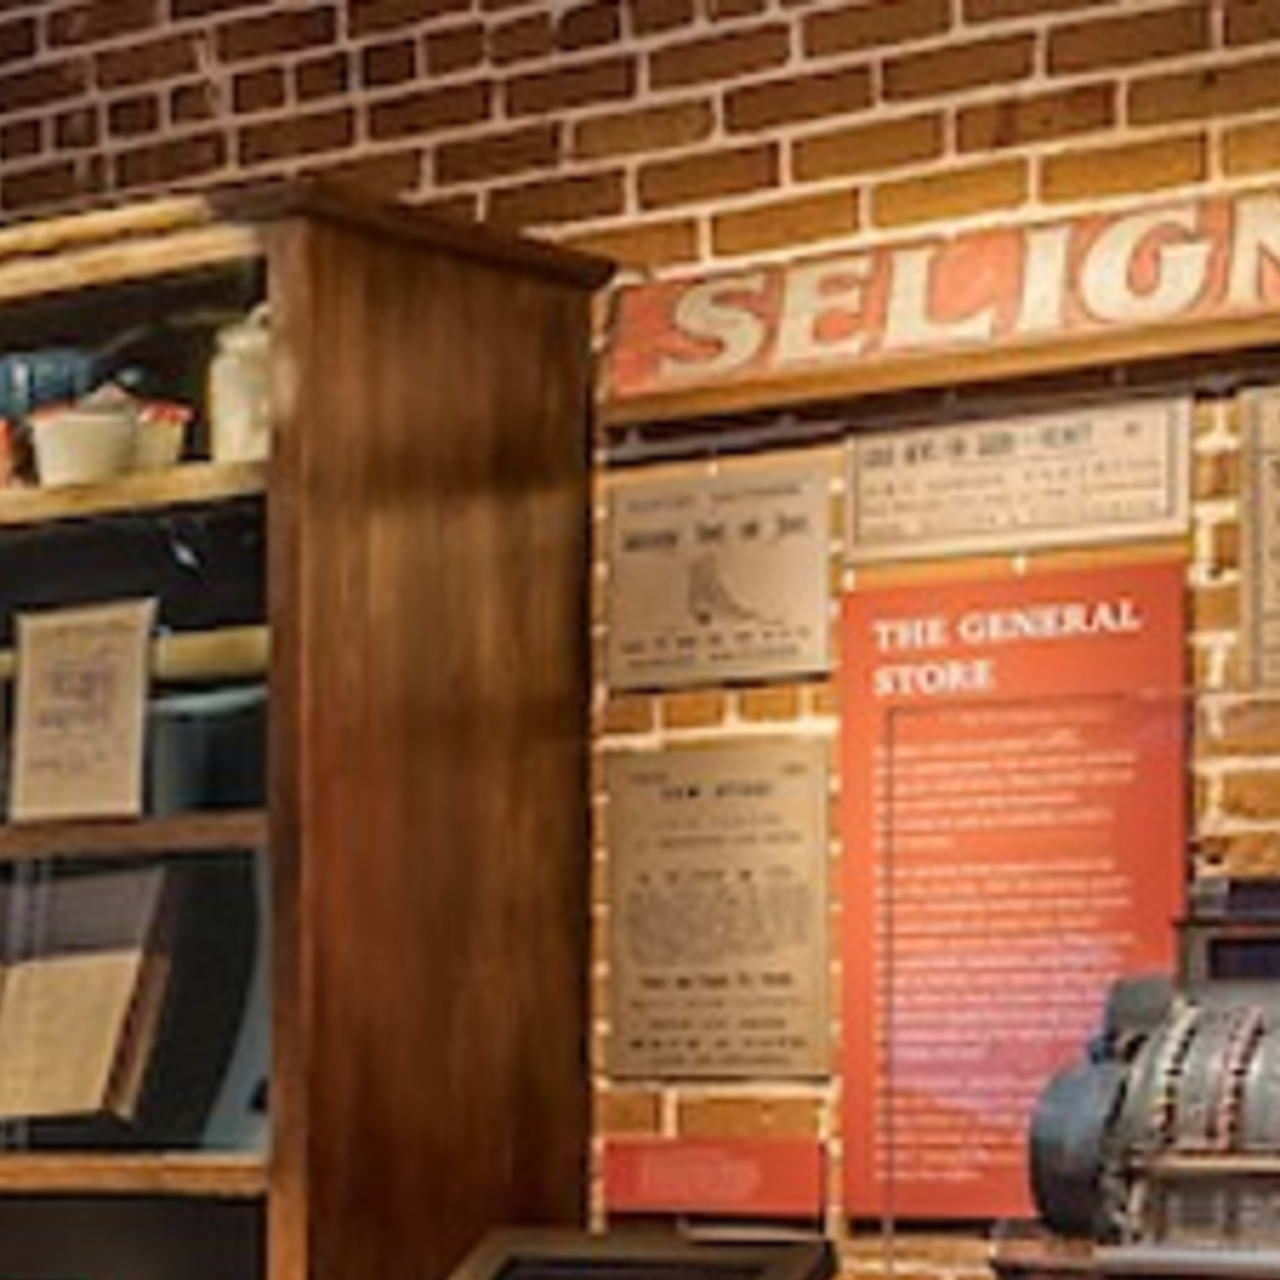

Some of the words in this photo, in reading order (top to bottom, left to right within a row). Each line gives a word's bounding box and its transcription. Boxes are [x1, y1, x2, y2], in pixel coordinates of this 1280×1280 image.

[874, 617, 951, 651] THE
[957, 600, 1143, 642] GENERAL
[874, 659, 992, 696] STORE
